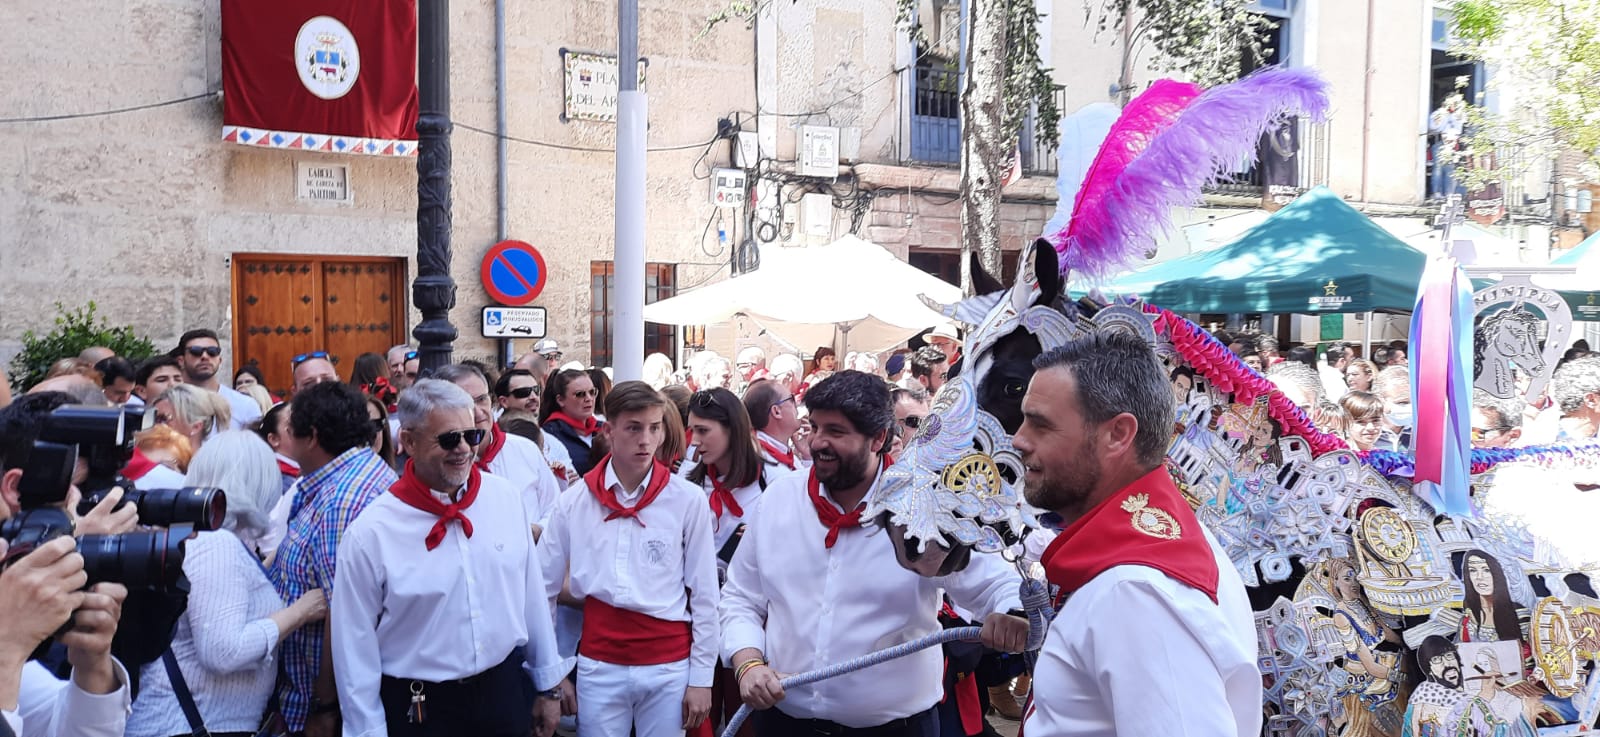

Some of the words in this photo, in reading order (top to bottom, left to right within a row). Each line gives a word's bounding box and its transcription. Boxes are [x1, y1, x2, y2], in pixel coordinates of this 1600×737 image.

[597, 72, 617, 86] PLA
[576, 93, 595, 106] DEL
[1308, 296, 1352, 304] ESTRELLA
[1473, 286, 1562, 312] MINIPUA
